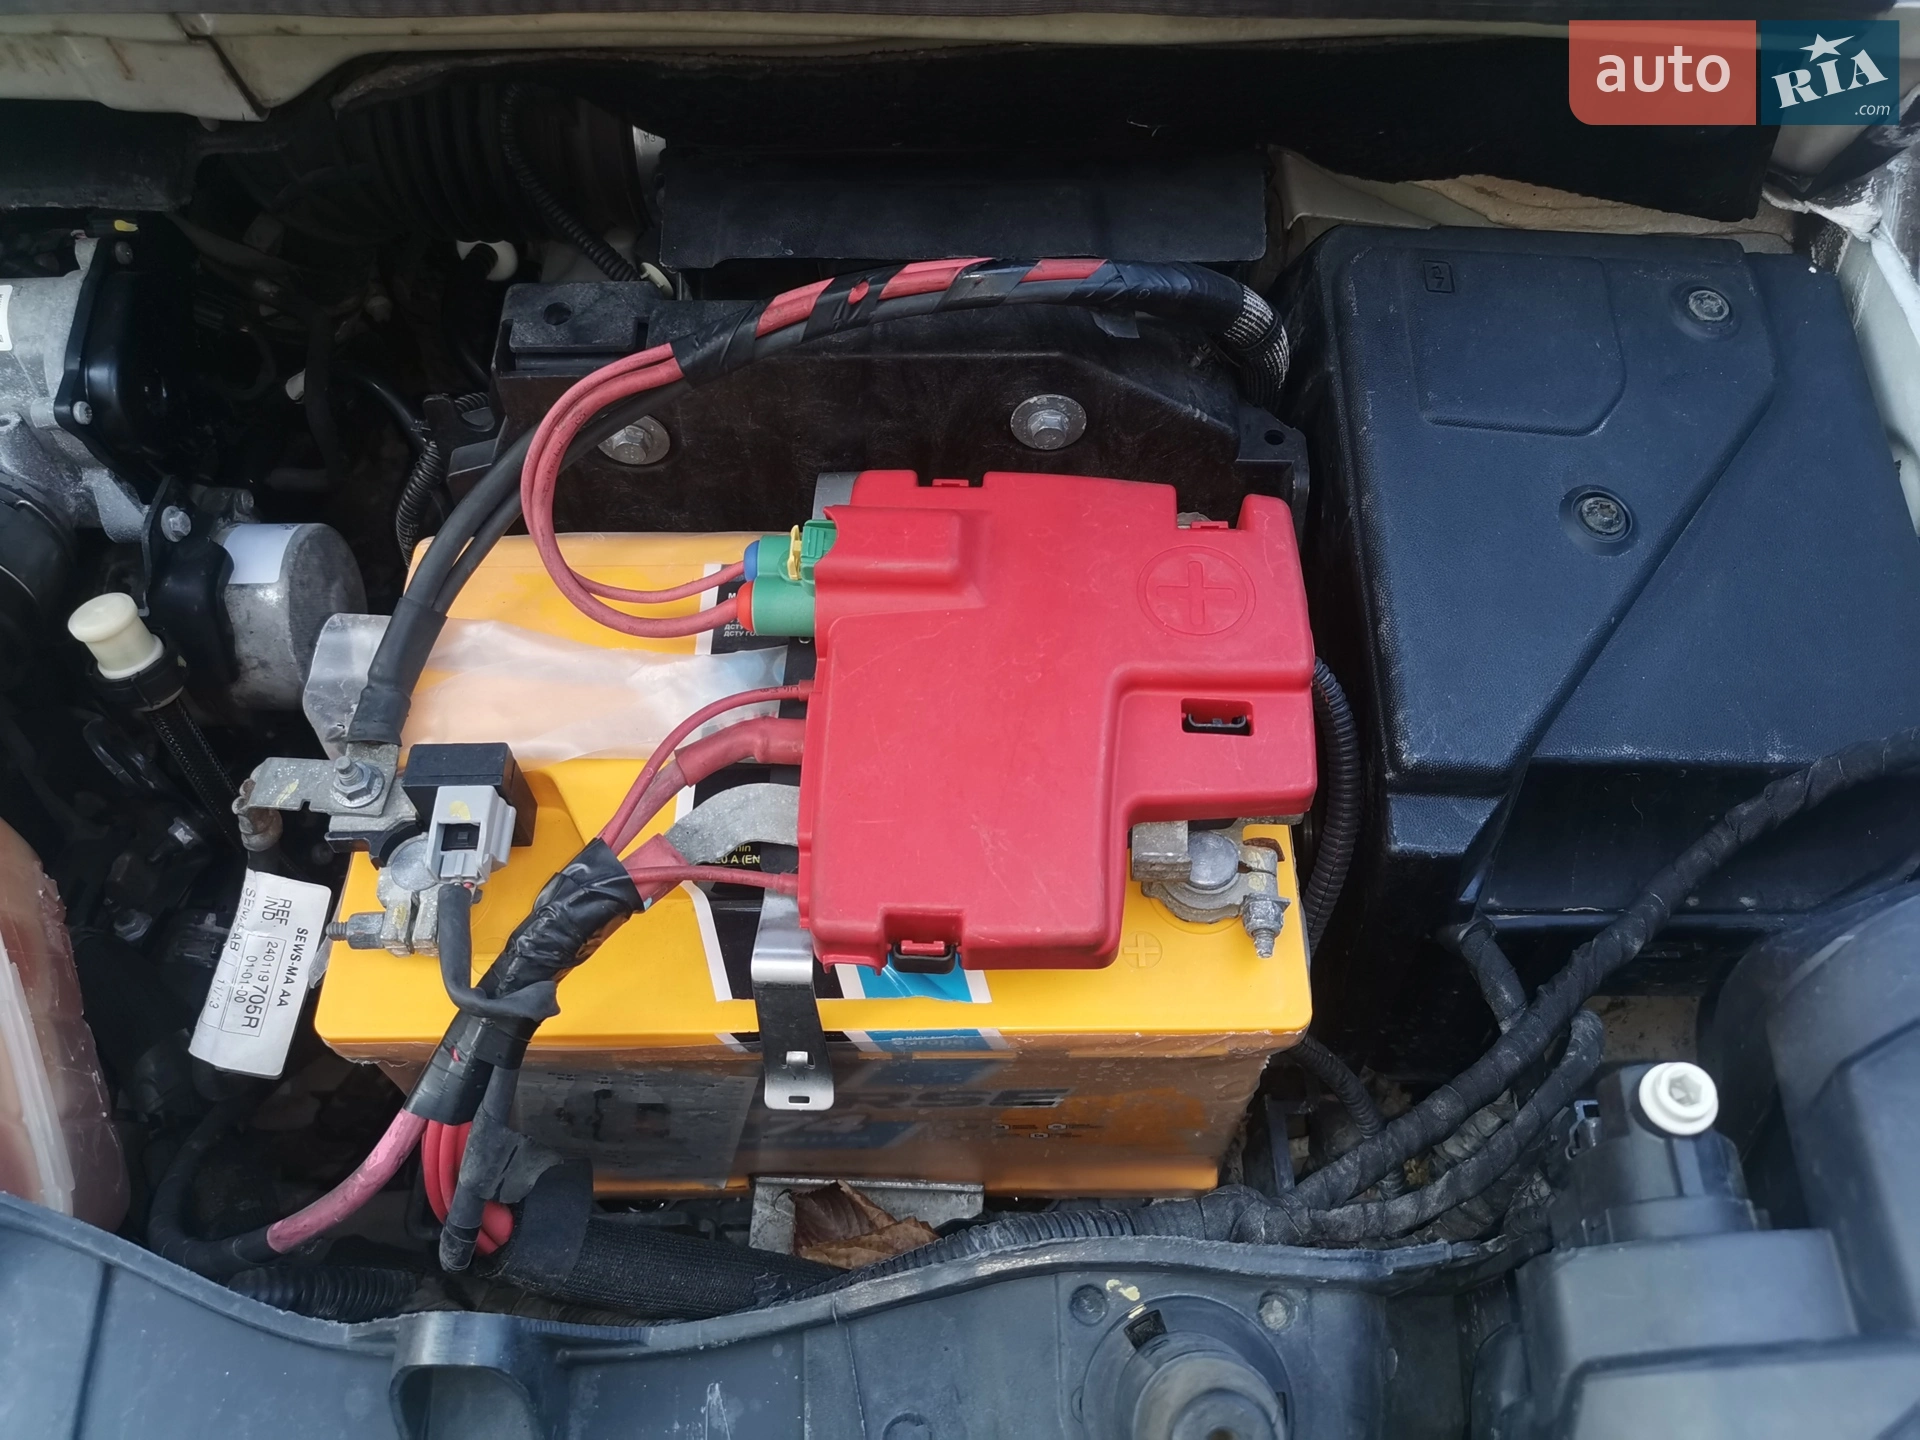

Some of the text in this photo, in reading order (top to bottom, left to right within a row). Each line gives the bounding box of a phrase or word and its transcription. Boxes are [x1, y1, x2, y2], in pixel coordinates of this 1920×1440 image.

[234, 955, 258, 1003] 01-01-00
[276, 927, 309, 1008] SEWS-MA AA
